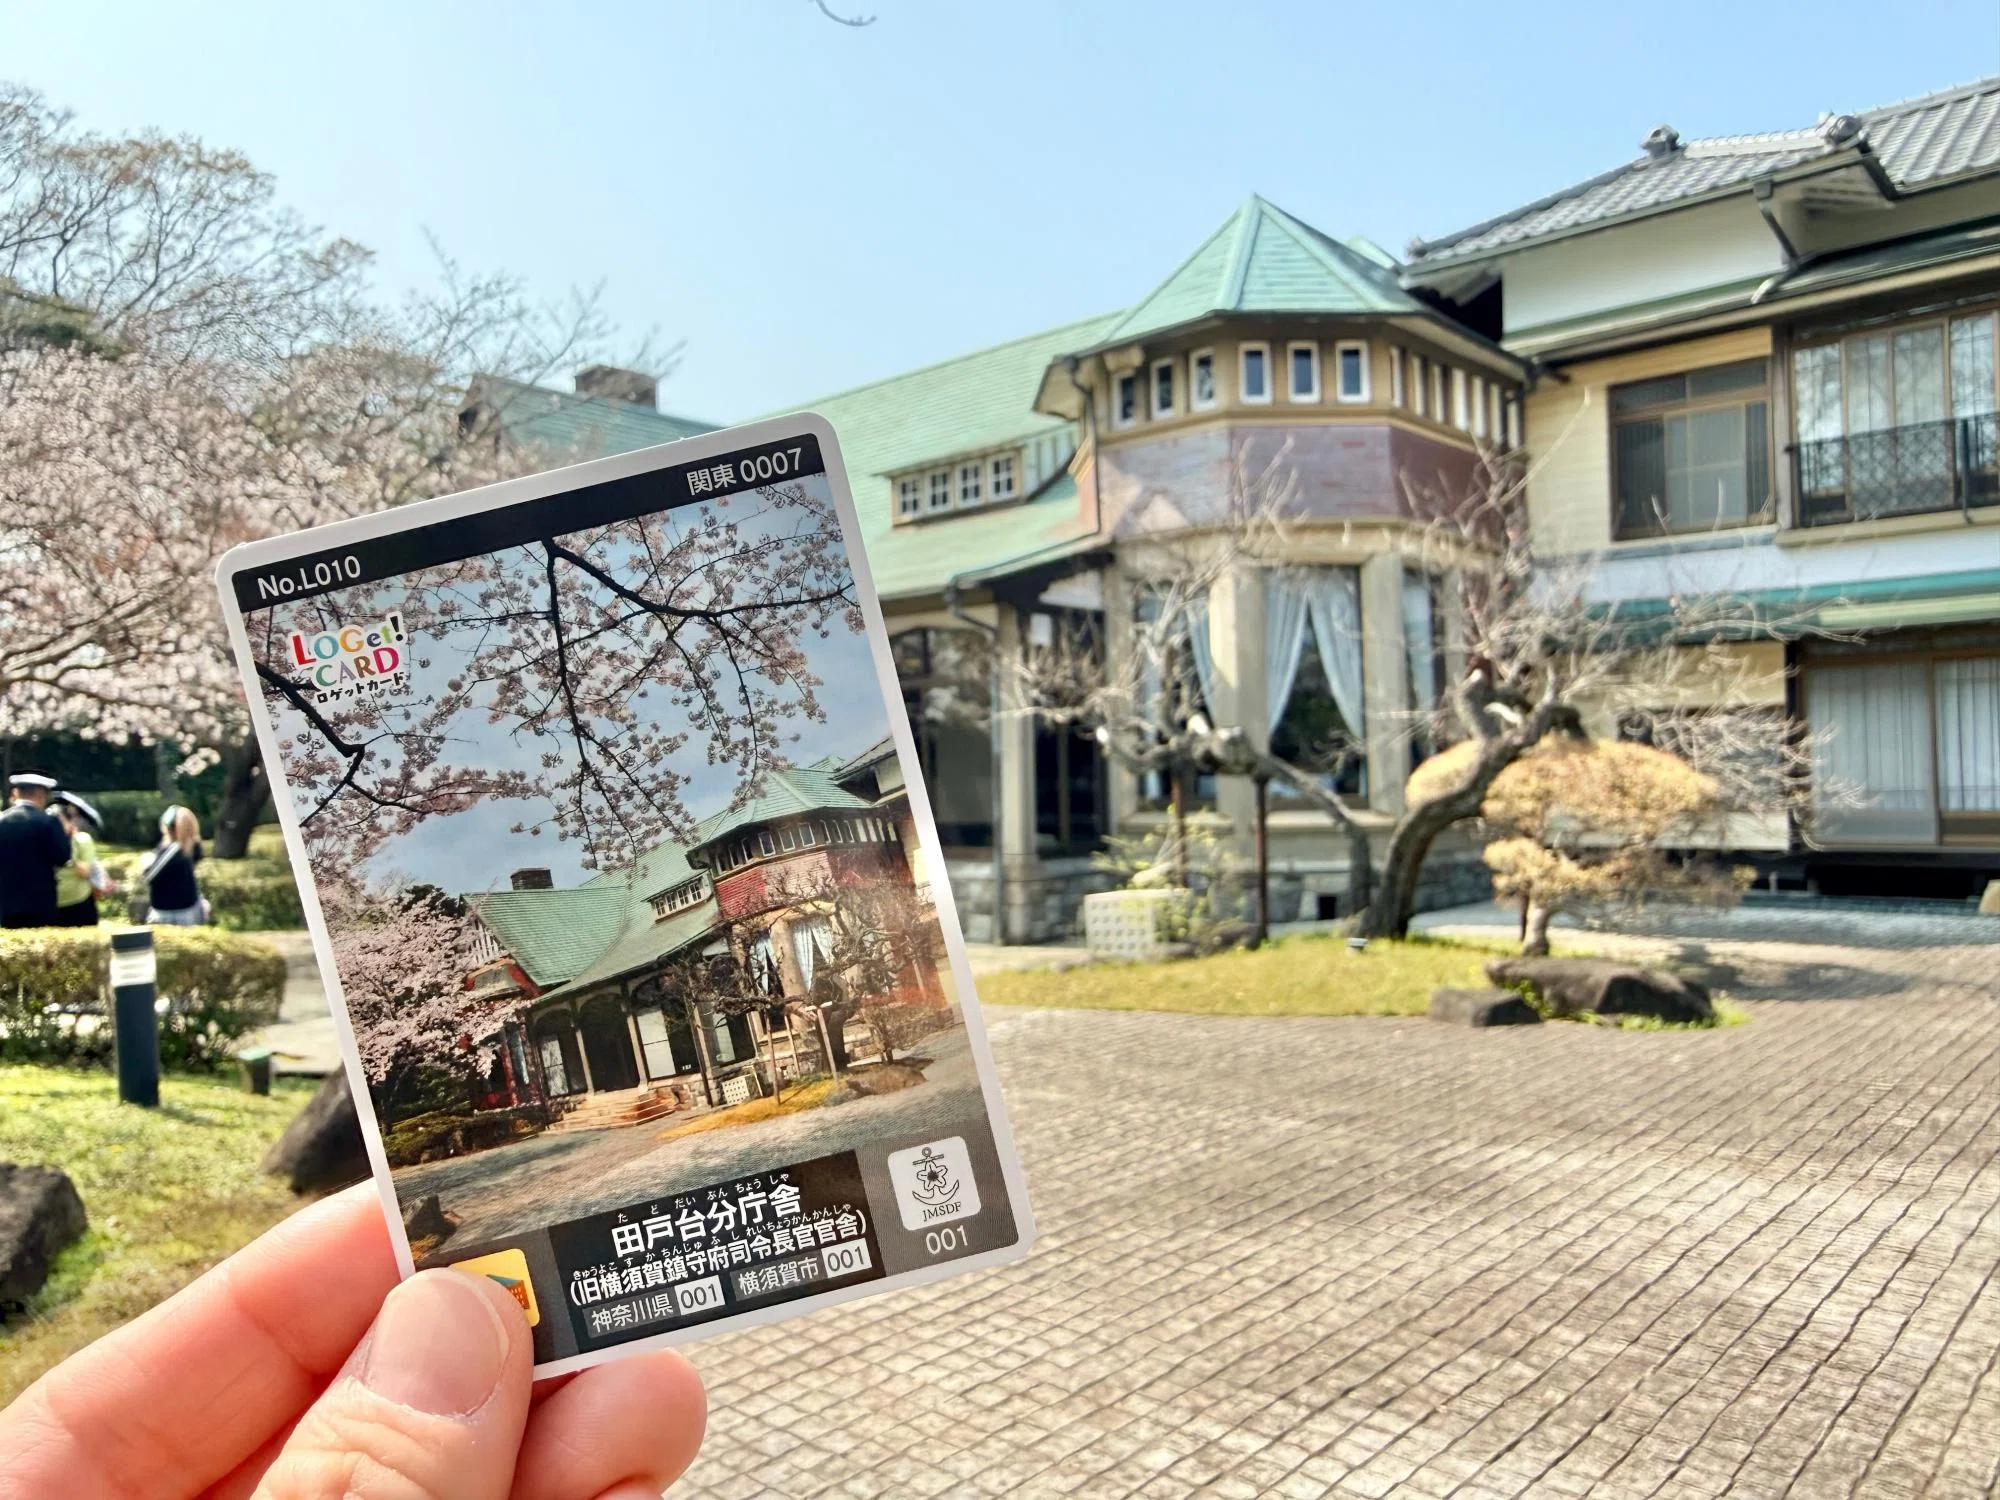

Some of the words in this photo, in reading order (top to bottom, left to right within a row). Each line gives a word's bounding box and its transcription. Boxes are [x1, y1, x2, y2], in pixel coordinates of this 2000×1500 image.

[687, 463, 737, 496] 関東
[740, 447, 802, 483] 0007
[257, 555, 361, 599] No.L010
[292, 616, 404, 665] LOGet!
[315, 647, 400, 687] CARD
[317, 672, 405, 704] ロゲットカード
[611, 1183, 801, 1258] 田戸台分庁舎
[617, 1212, 629, 1224] た
[734, 1178, 762, 1194] ちょう
[769, 1173, 790, 1185] しゃ
[922, 1200, 962, 1222] JMSDF
[570, 1209, 867, 1306] (旧横須賀鎮守府司令長官官舎)
[925, 1225, 968, 1254] 001
[738, 1256, 819, 1295] 横須賀市
[827, 1246, 865, 1272] 001
[591, 1293, 674, 1333] 神奈川県
[680, 1283, 718, 1309] 001
